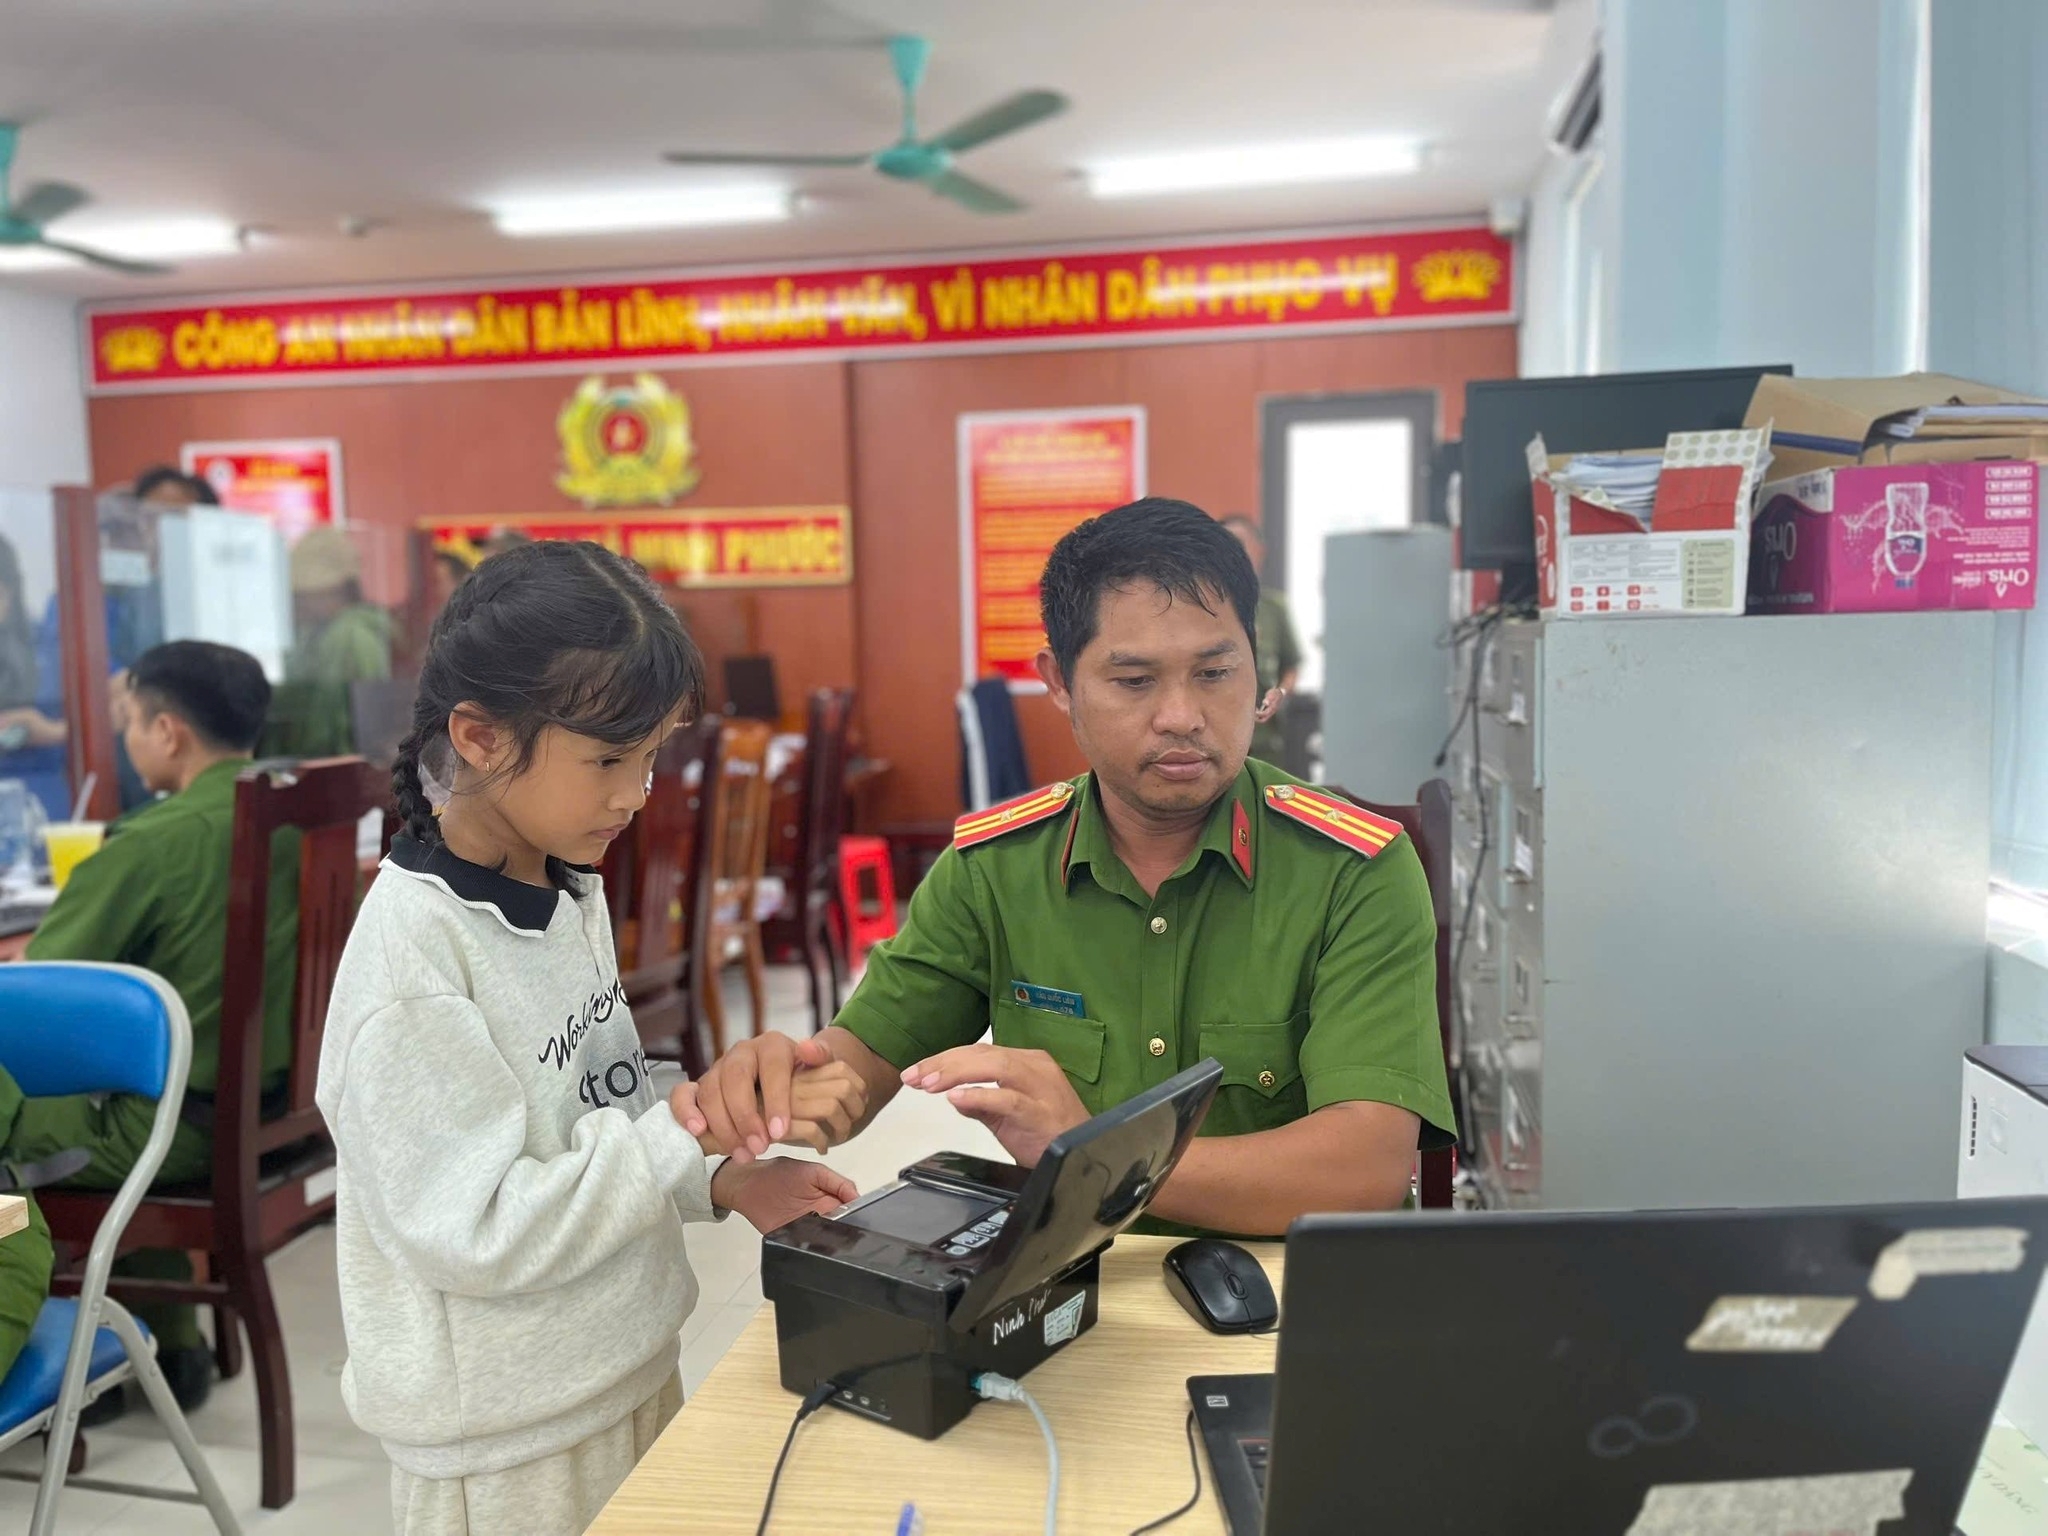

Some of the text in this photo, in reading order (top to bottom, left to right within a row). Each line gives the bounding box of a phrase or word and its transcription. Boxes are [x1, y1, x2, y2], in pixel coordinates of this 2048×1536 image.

[172, 309, 278, 369] CÔNG
[283, 314, 337, 364] AN
[341, 302, 445, 362] NHÂN
[451, 294, 528, 357] DÂN
[930, 266, 976, 331] VÌ
[983, 261, 1098, 328] NHÂN
[1107, 256, 1197, 321] DÂN
[1205, 254, 1321, 321] PHỤC
[1338, 253, 1398, 315] VỤ
[1988, 567, 2030, 592] Oris
[538, 985, 614, 1071] Working
[993, 1307, 1025, 1346] Ninh
